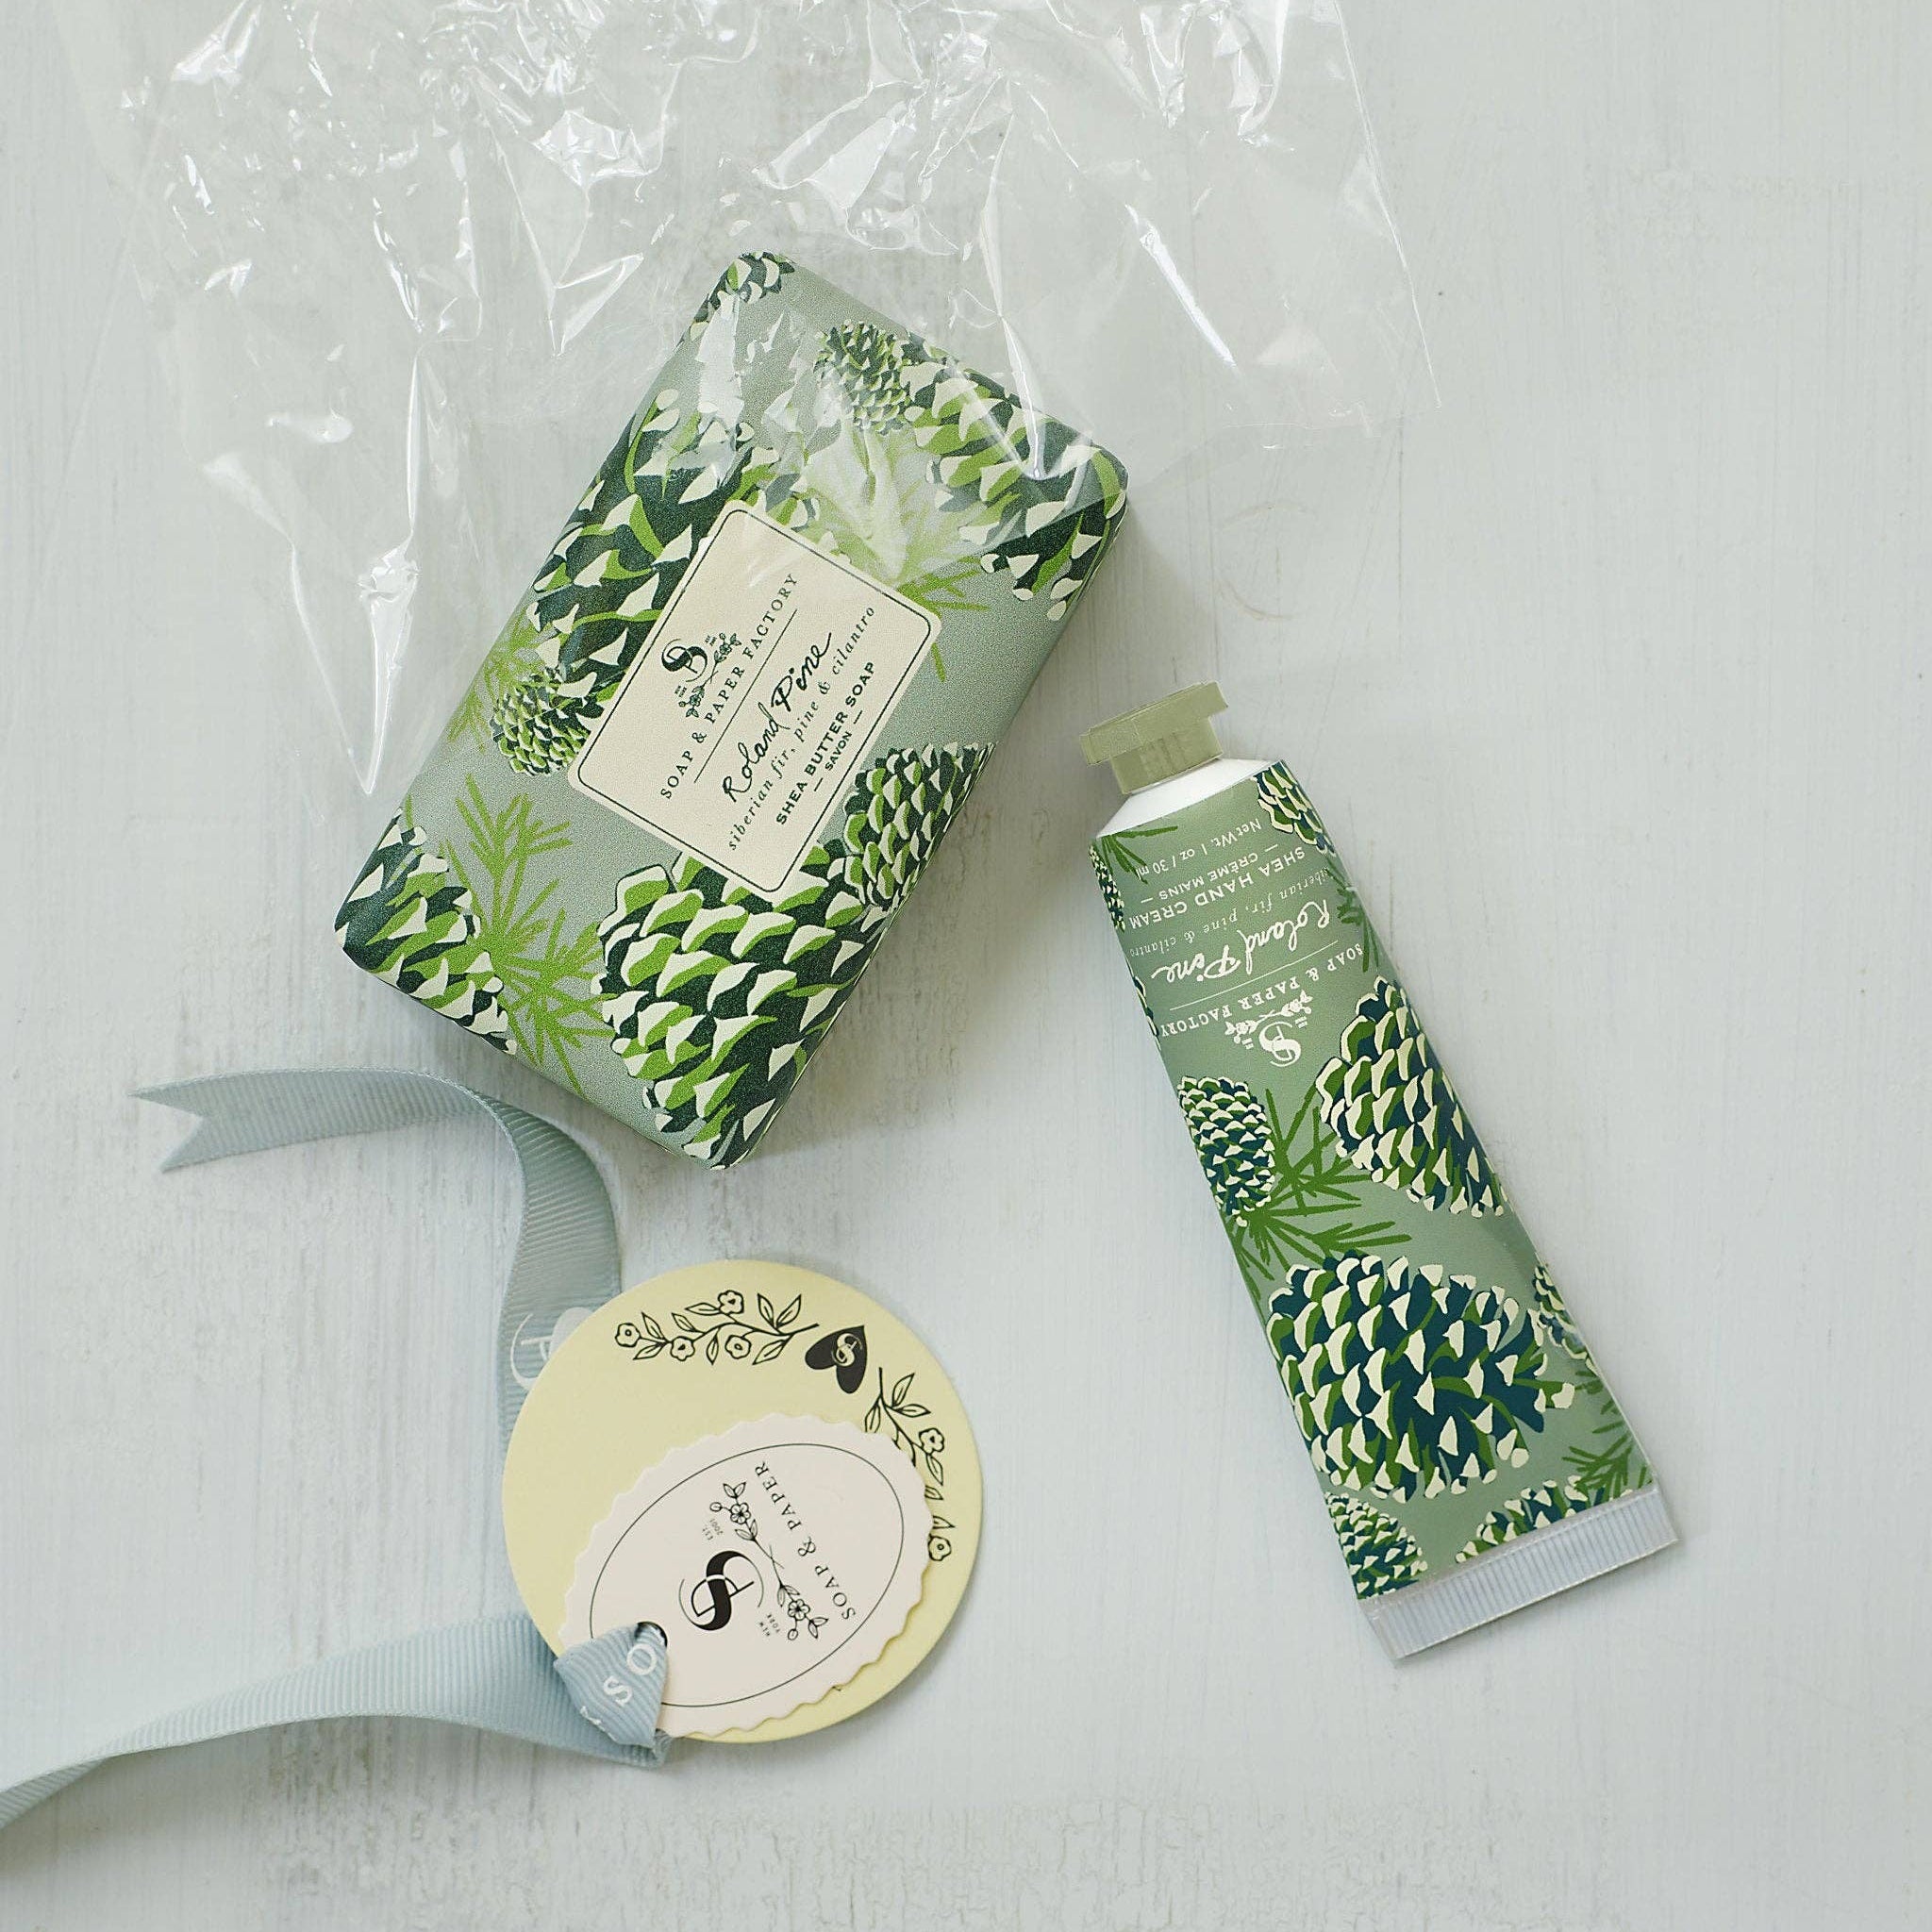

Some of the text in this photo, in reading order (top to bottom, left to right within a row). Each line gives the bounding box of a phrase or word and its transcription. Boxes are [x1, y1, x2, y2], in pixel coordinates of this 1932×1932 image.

[659, 574, 797, 800] SOAP & PAPER FACTORY
[722, 632, 832, 803] Roland Pine
[728, 607, 874, 851] siberian fir, pine & cilantro
[775, 661, 874, 825] SHEA BUTTER SOAP
[824, 730, 853, 772] SAVON
[1128, 846, 1306, 929] SHEA HAND CREAM
[1135, 865, 1150, 880] ml
[1152, 858, 1169, 874] 30
[1158, 852, 1258, 900] CRÈME MAINS
[1179, 848, 1195, 861] oz
[1150, 899, 1330, 983] Roland Pine
[1183, 930, 1195, 944] &
[1202, 908, 1238, 934] pine
[1160, 942, 1364, 1037] SOAP & PAPER FACTORY
[755, 1461, 857, 1620] SOAP & PAPER
